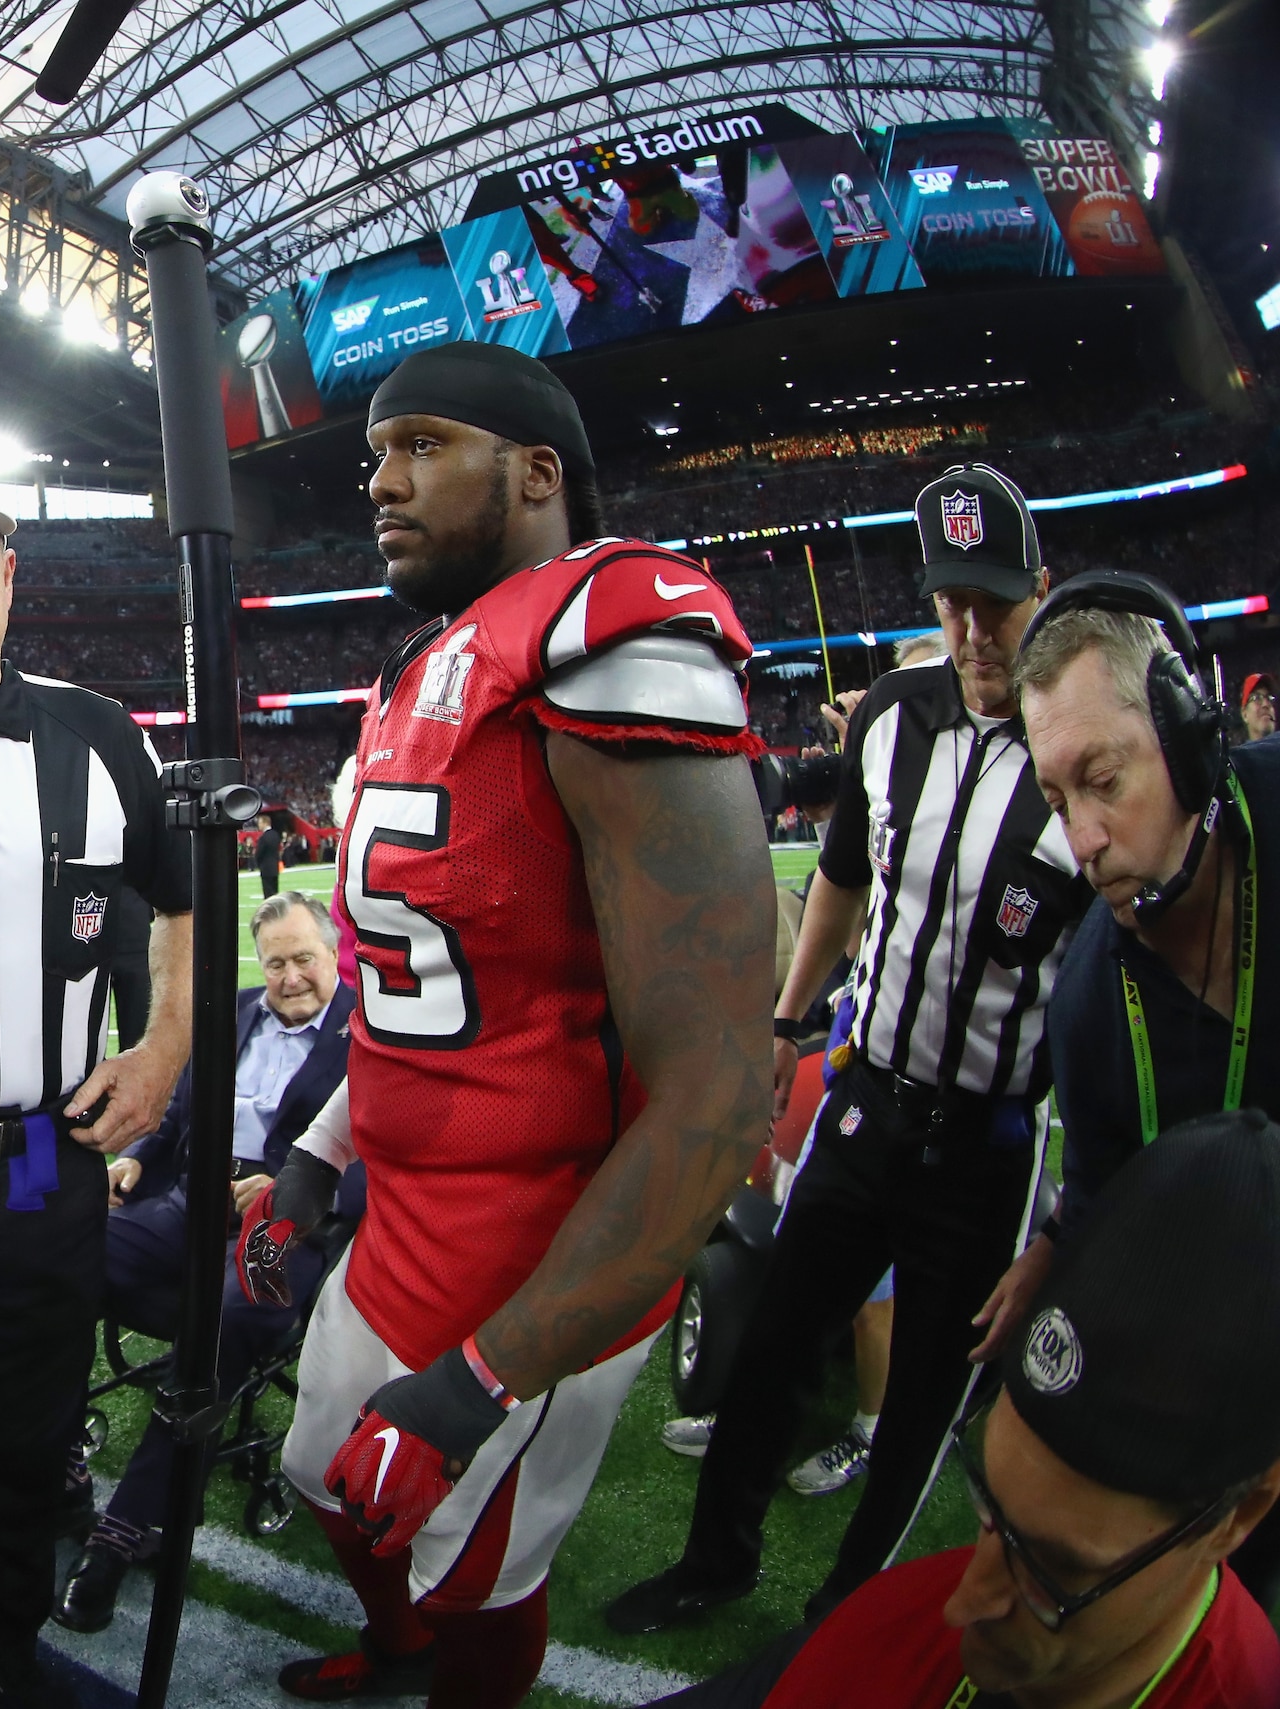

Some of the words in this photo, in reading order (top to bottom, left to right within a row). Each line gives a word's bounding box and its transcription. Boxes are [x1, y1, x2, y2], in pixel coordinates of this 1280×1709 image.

[516, 159, 580, 193] nrg
[615, 113, 763, 166] stadium
[1020, 139, 1114, 164] SUPER
[913, 172, 953, 195] SAP
[965, 181, 982, 190] Run
[983, 179, 1009, 190] Simple
[1032, 165, 1131, 193] BOWL
[922, 211, 975, 233] COIN
[977, 206, 1036, 228] TOSS
[332, 304, 372, 332] SAP
[382, 306, 400, 317] Run
[401, 296, 429, 312] Simple
[490, 310, 513, 320] SUPER
[515, 305, 535, 313] BOWL
[333, 337, 383, 368] COIN
[388, 316, 449, 350] TOSS
[947, 516, 979, 543] NFL
[184, 624, 197, 724] Manfrotto
[1205, 801, 1218, 828] ATK
[76, 915, 99, 936] NFL
[340, 781, 482, 1051] 5
[999, 903, 1027, 932] NFL
[1234, 1026, 1247, 1047] LI
[1035, 1319, 1070, 1371] FOX
